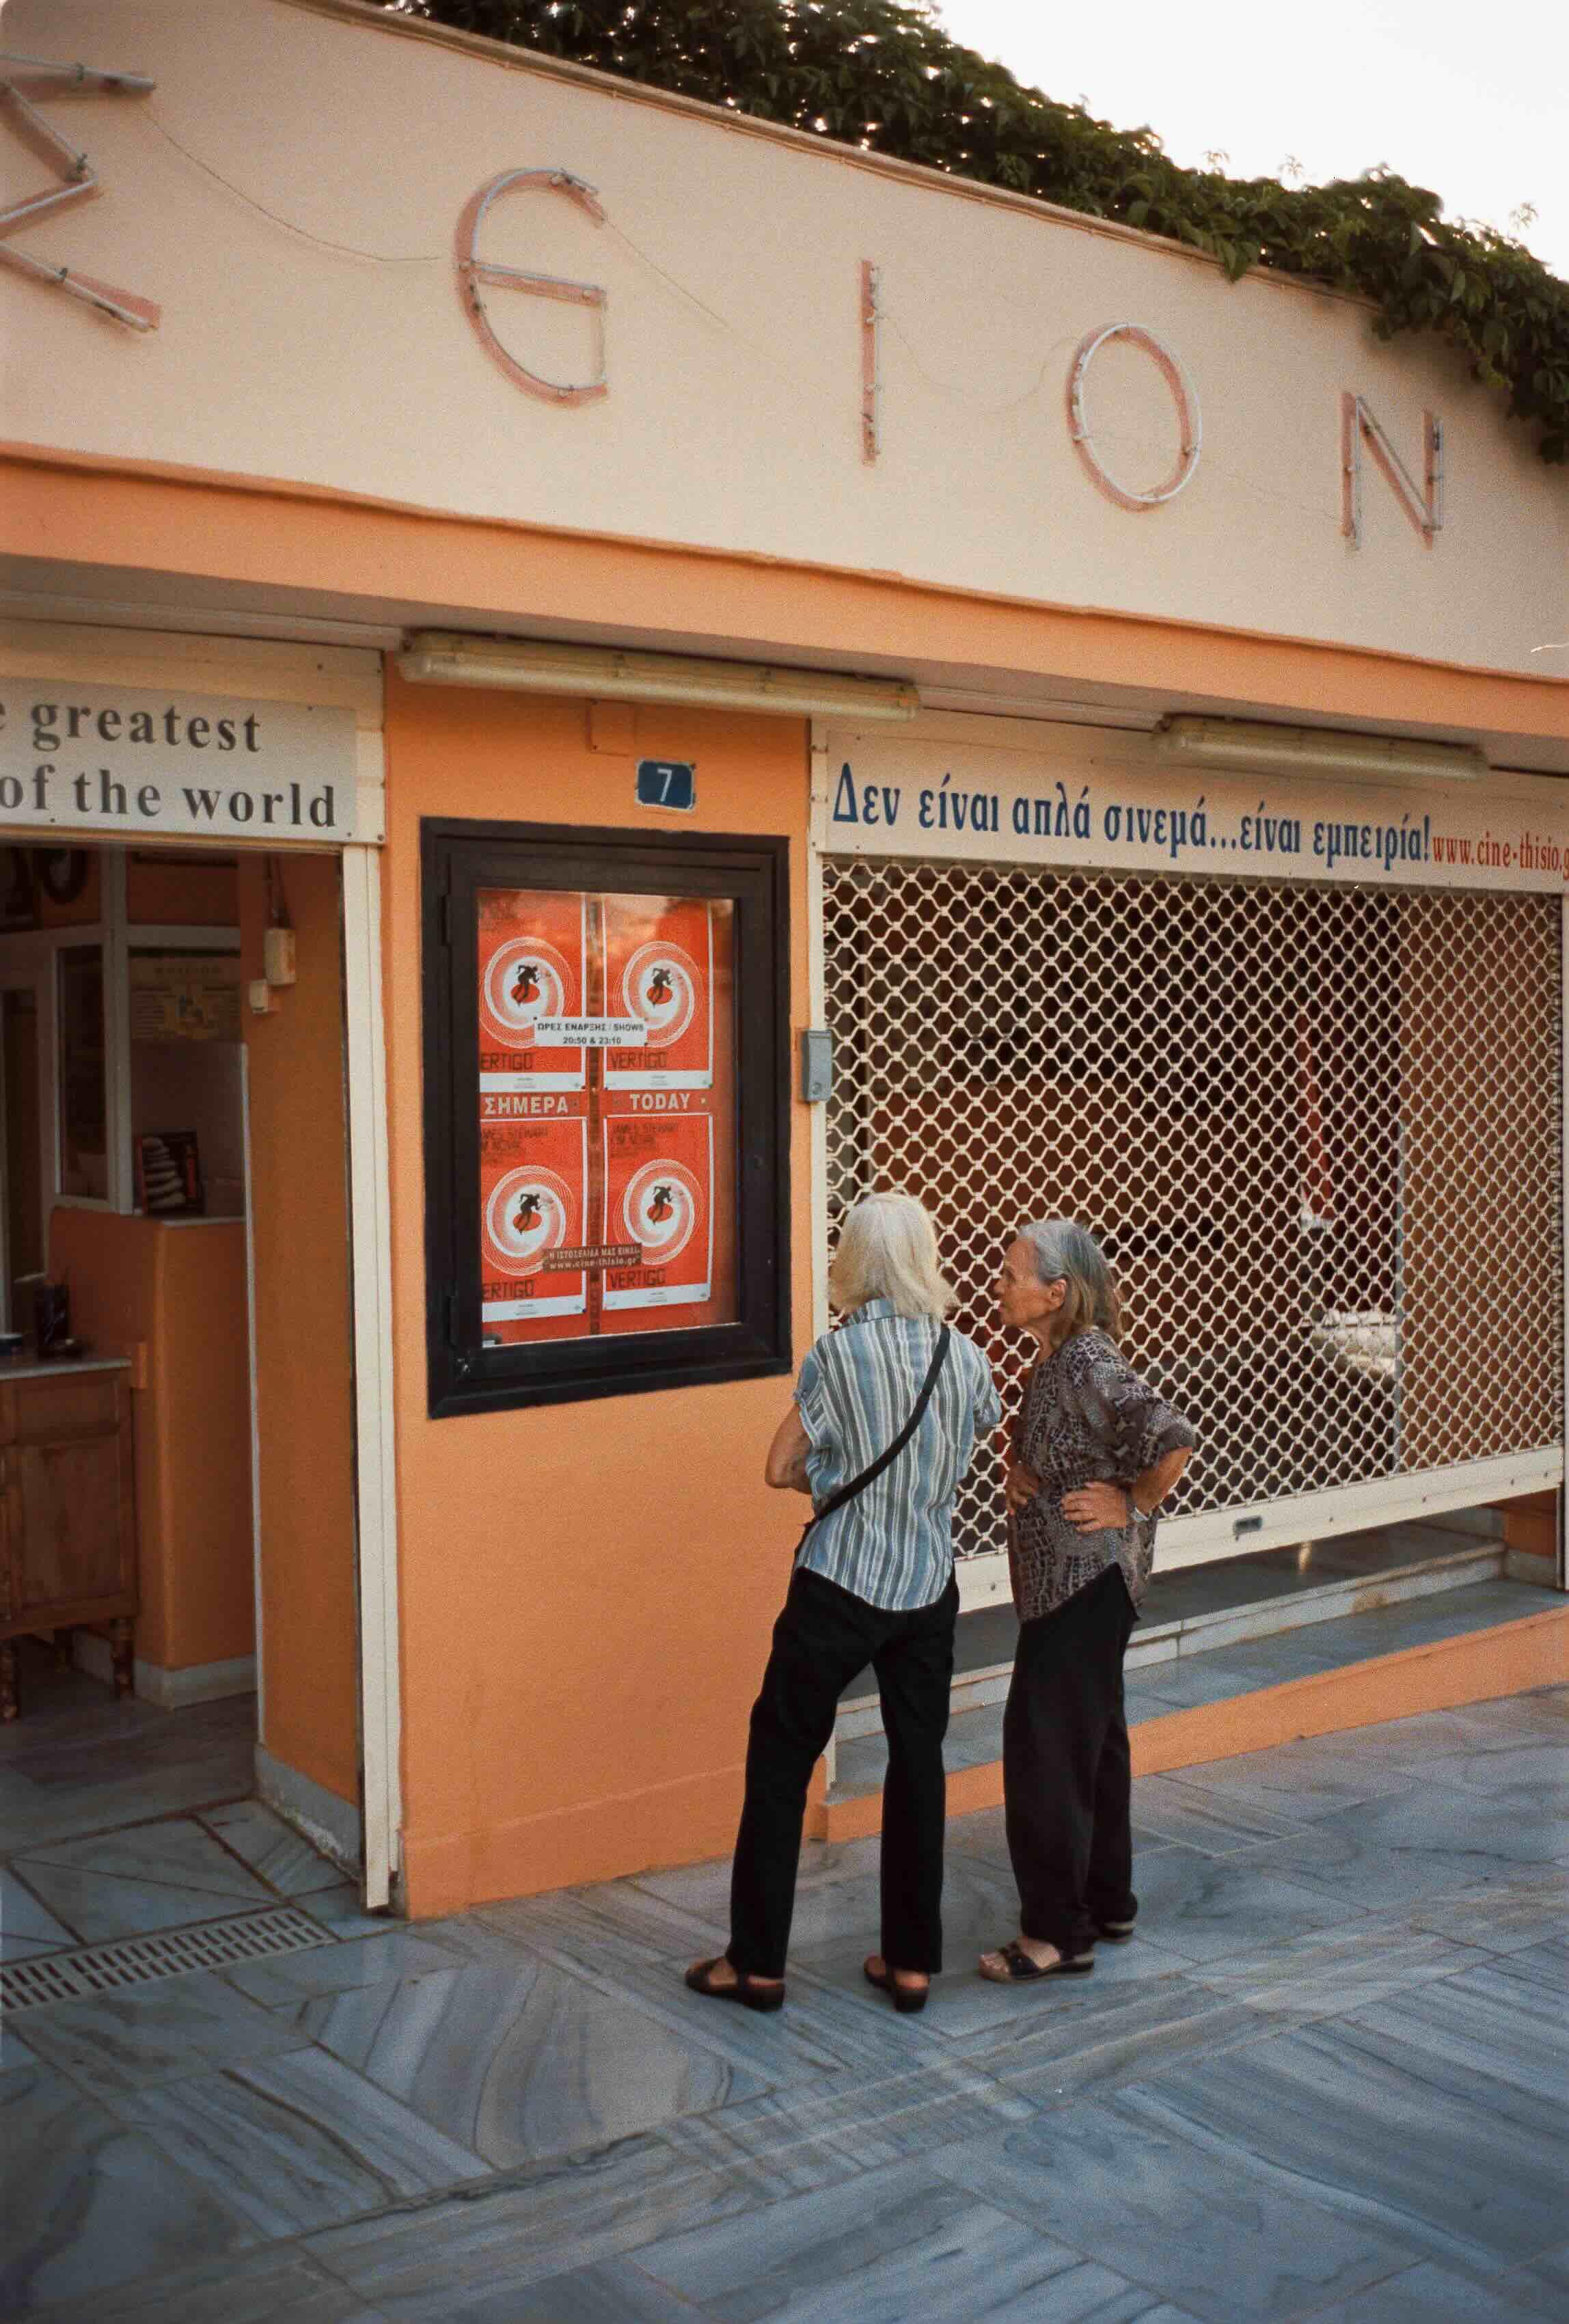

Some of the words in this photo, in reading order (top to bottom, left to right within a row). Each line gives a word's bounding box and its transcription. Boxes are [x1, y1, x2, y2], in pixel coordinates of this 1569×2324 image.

[31, 702, 261, 753] greatest
[0, 764, 55, 810] of
[72, 768, 161, 817] the
[182, 783, 336, 827] world
[657, 768, 672, 802] 7
[832, 762, 901, 826] Δεν
[918, 772, 999, 833] είναι
[1012, 781, 1091, 839] απλά
[1312, 813, 1430, 871] εμπειρία!
[537, 1023, 562, 1031] ΩΡΕΣ
[565, 1023, 606, 1031] ΕΝΑΡΞΗΣ
[614, 1023, 644, 1031] SHOWS
[563, 1036, 587, 1045] 20:50
[590, 1036, 596, 1045] &
[599, 1036, 622, 1045] 23:10
[480, 1052, 532, 1070] ERTIGO
[611, 1051, 667, 1069] VERTIGO
[484, 1095, 569, 1116] ΣΗΜΕΡΑ
[629, 1093, 691, 1111] TODAY
[610, 1268, 666, 1289] VERTIGO
[481, 1279, 535, 1301] ERTIGO
